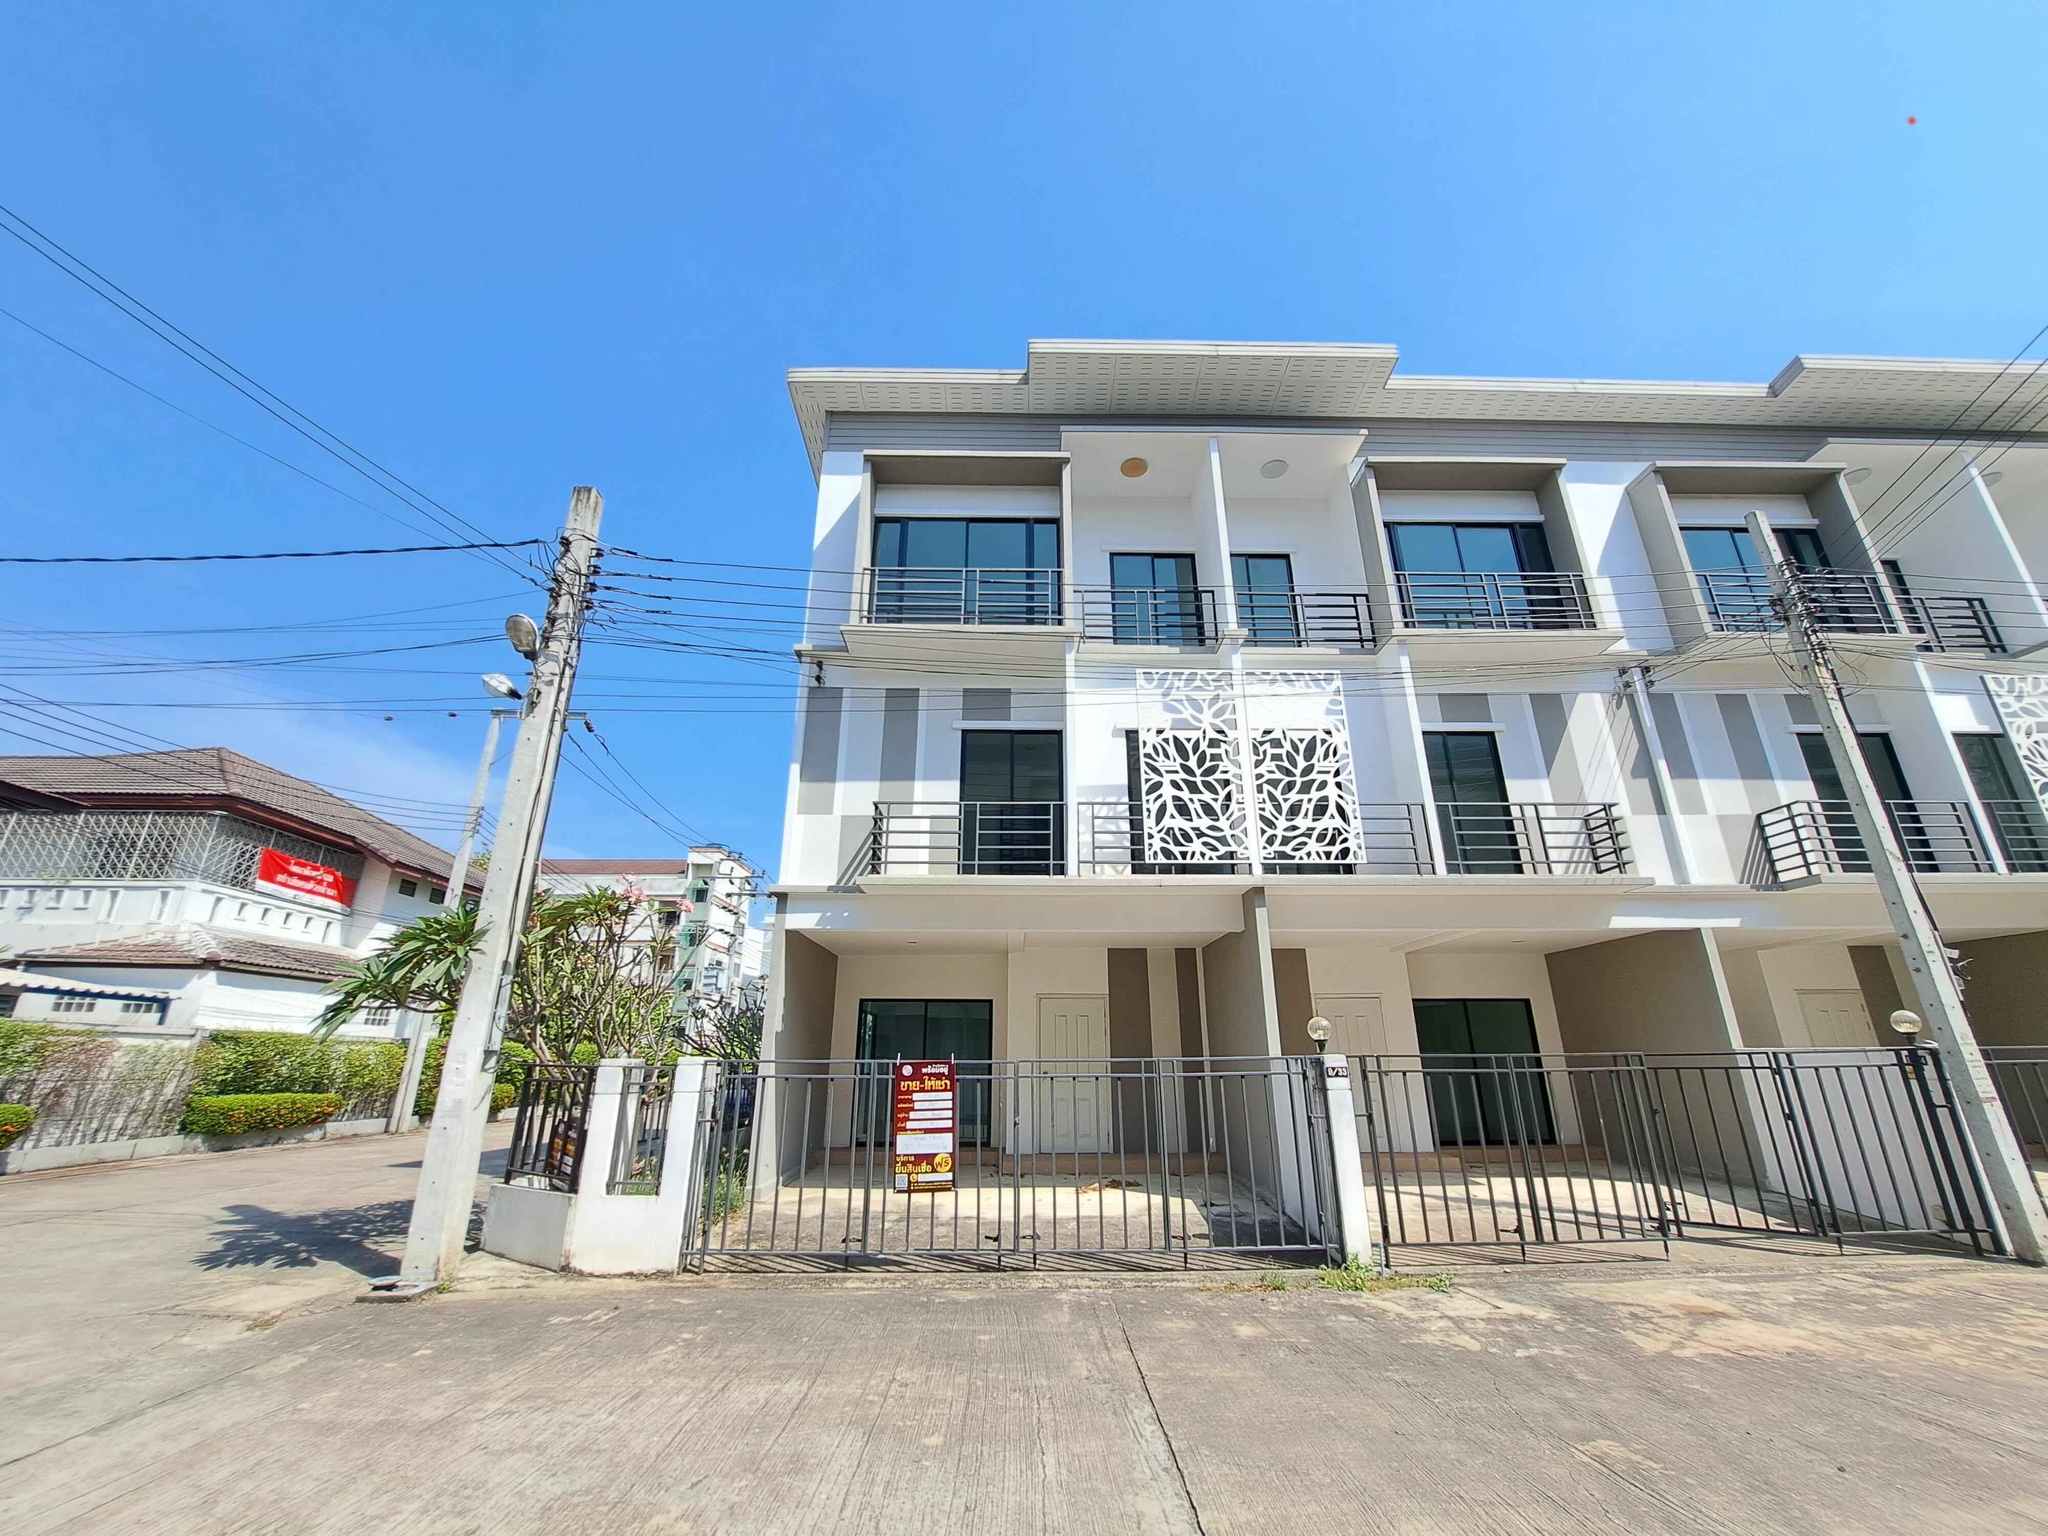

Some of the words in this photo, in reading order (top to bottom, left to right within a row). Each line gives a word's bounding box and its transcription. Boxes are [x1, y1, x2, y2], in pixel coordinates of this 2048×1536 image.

[1327, 1067, 1347, 1076] 9/33
[900, 1076, 950, 1091] ขาย-ให้เช่า
[896, 1154, 915, 1162] บริการ
[895, 1160, 932, 1174] ยื่นสินเชื่อ
